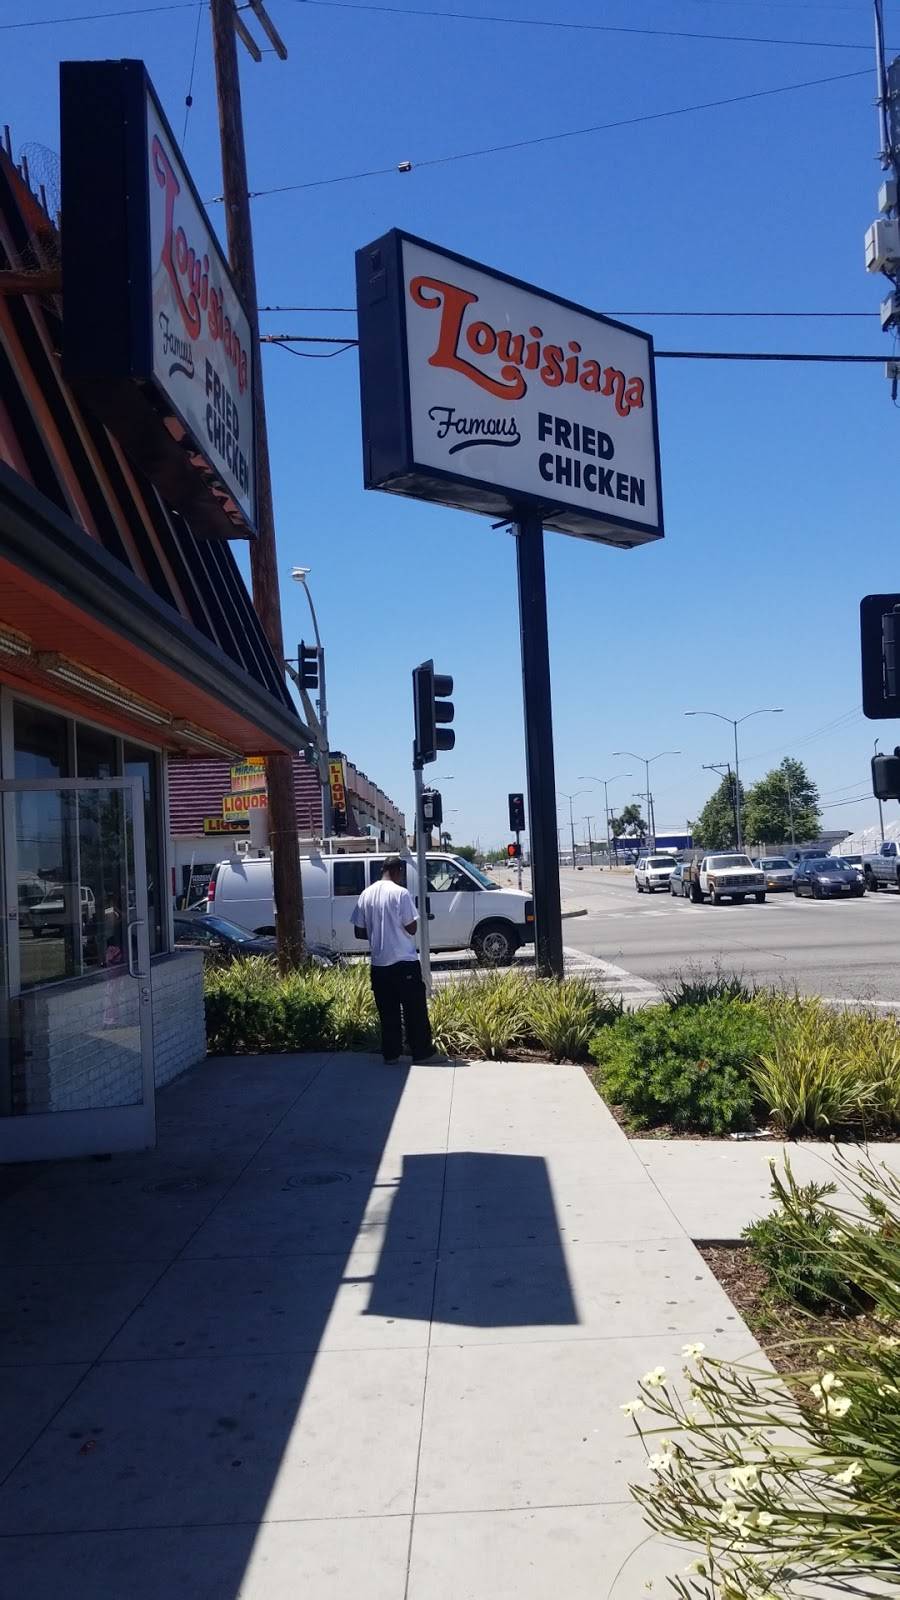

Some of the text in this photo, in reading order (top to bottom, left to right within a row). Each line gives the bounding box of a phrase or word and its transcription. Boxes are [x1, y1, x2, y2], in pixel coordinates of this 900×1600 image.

[152, 134, 248, 396] Louisiana
[159, 311, 195, 380] Famous
[410, 275, 645, 417] Louisiana
[205, 357, 240, 442] FRIED
[206, 402, 249, 497] CHICKEN
[428, 406, 521, 455] Famous
[538, 411, 615, 461] FRIED
[538, 451, 646, 507] CHICKEN
[224, 794, 267, 813] LIQUOR
[330, 765, 345, 810] LIQUO
[208, 819, 249, 831] LIQUO
